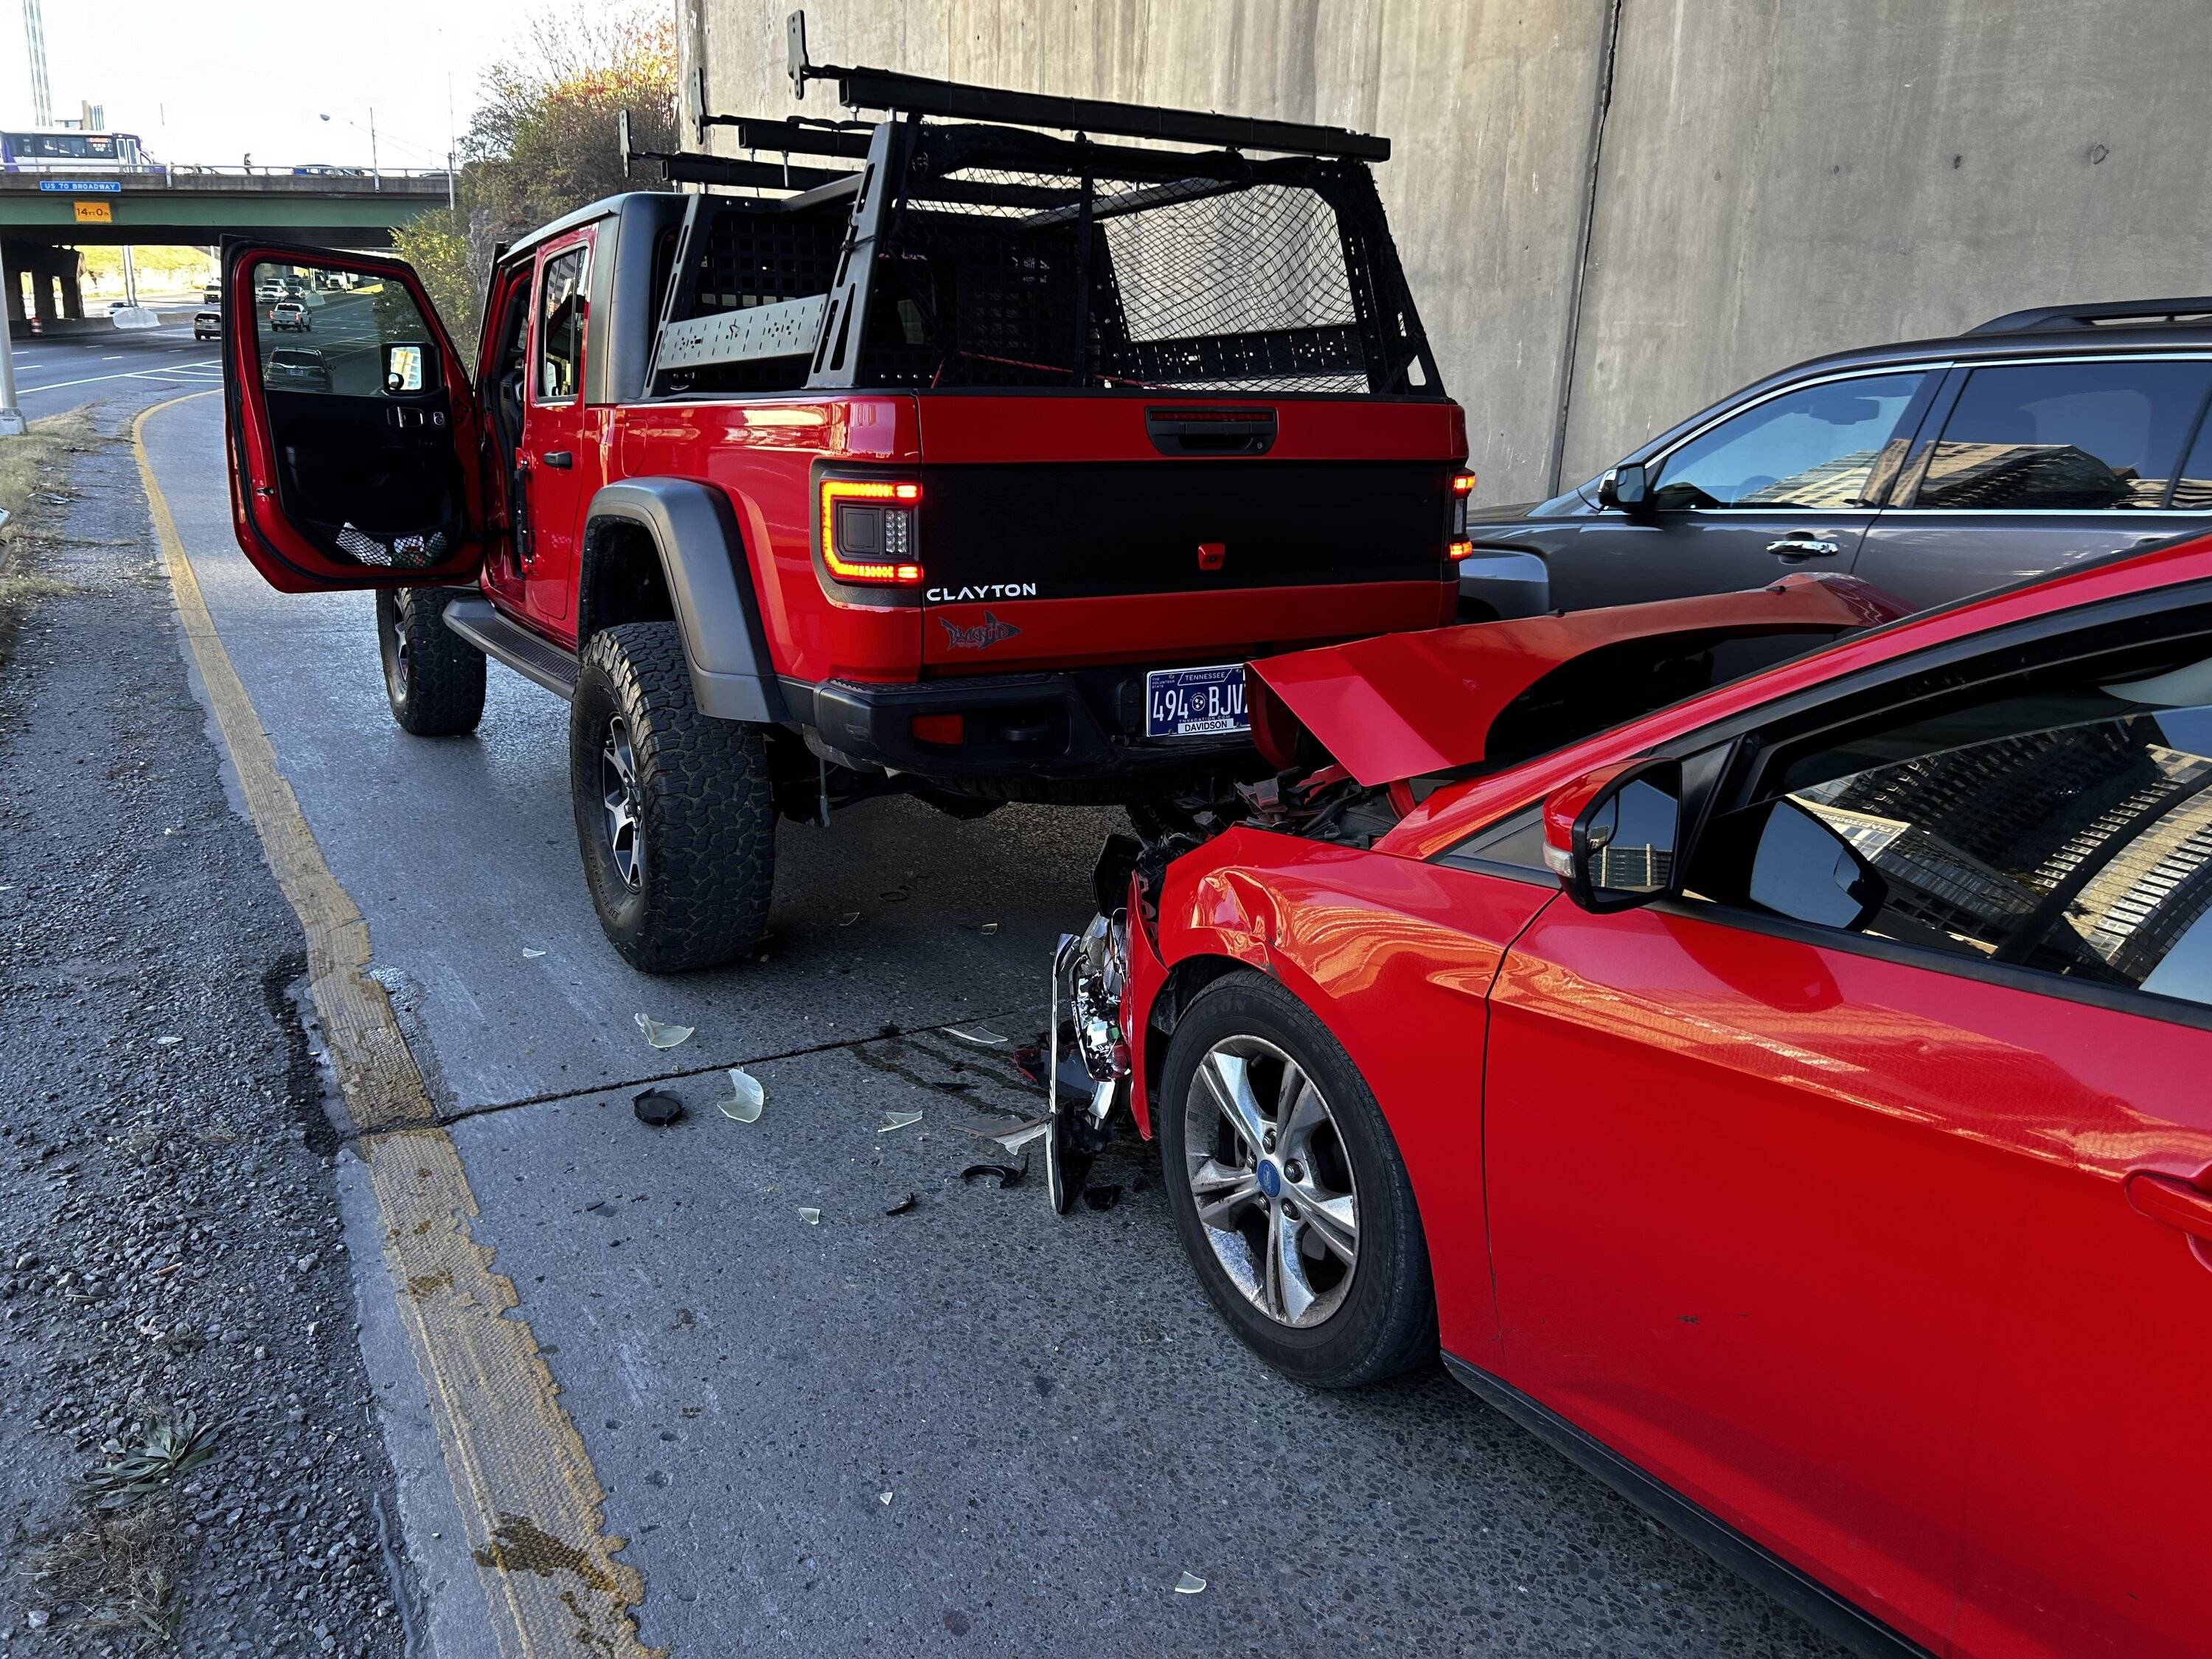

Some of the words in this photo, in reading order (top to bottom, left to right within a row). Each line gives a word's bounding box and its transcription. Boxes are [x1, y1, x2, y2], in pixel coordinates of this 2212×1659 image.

[76, 208, 88, 216] 14
[926, 582, 1037, 602] CLAYTON
[1185, 672, 1225, 681] TENNESSEE
[1152, 689, 1189, 722] 494
[1208, 683, 1248, 717] BJV
[1185, 720, 1228, 732] DAVIDSON
